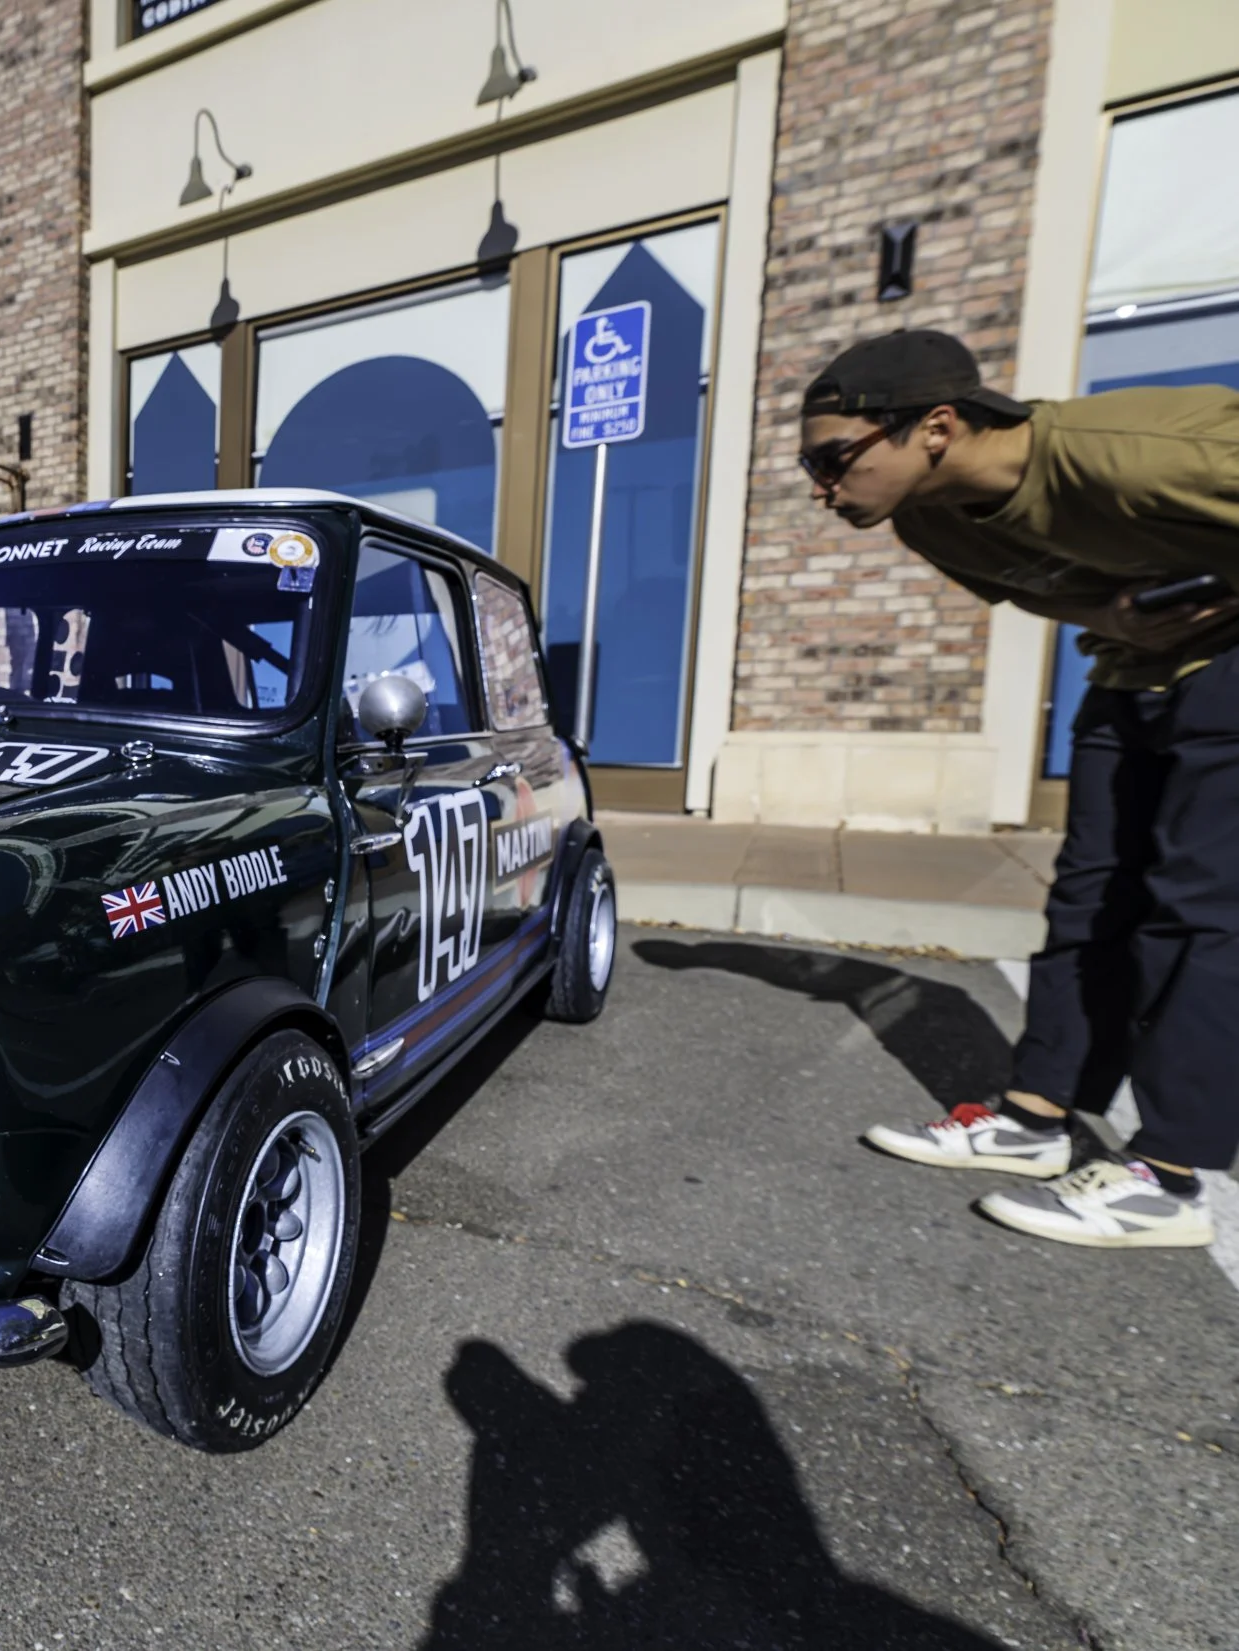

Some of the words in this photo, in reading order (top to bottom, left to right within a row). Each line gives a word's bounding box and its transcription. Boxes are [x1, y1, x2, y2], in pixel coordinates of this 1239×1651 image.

[574, 356, 642, 387] PARKING
[585, 380, 627, 405] ONLY
[77, 536, 136, 560] Racing
[136, 534, 182, 552] Team
[496, 816, 552, 877] MARTINI
[162, 862, 221, 920] ANDY
[219, 844, 288, 900] BIDDLE
[404, 788, 487, 1002] 147
